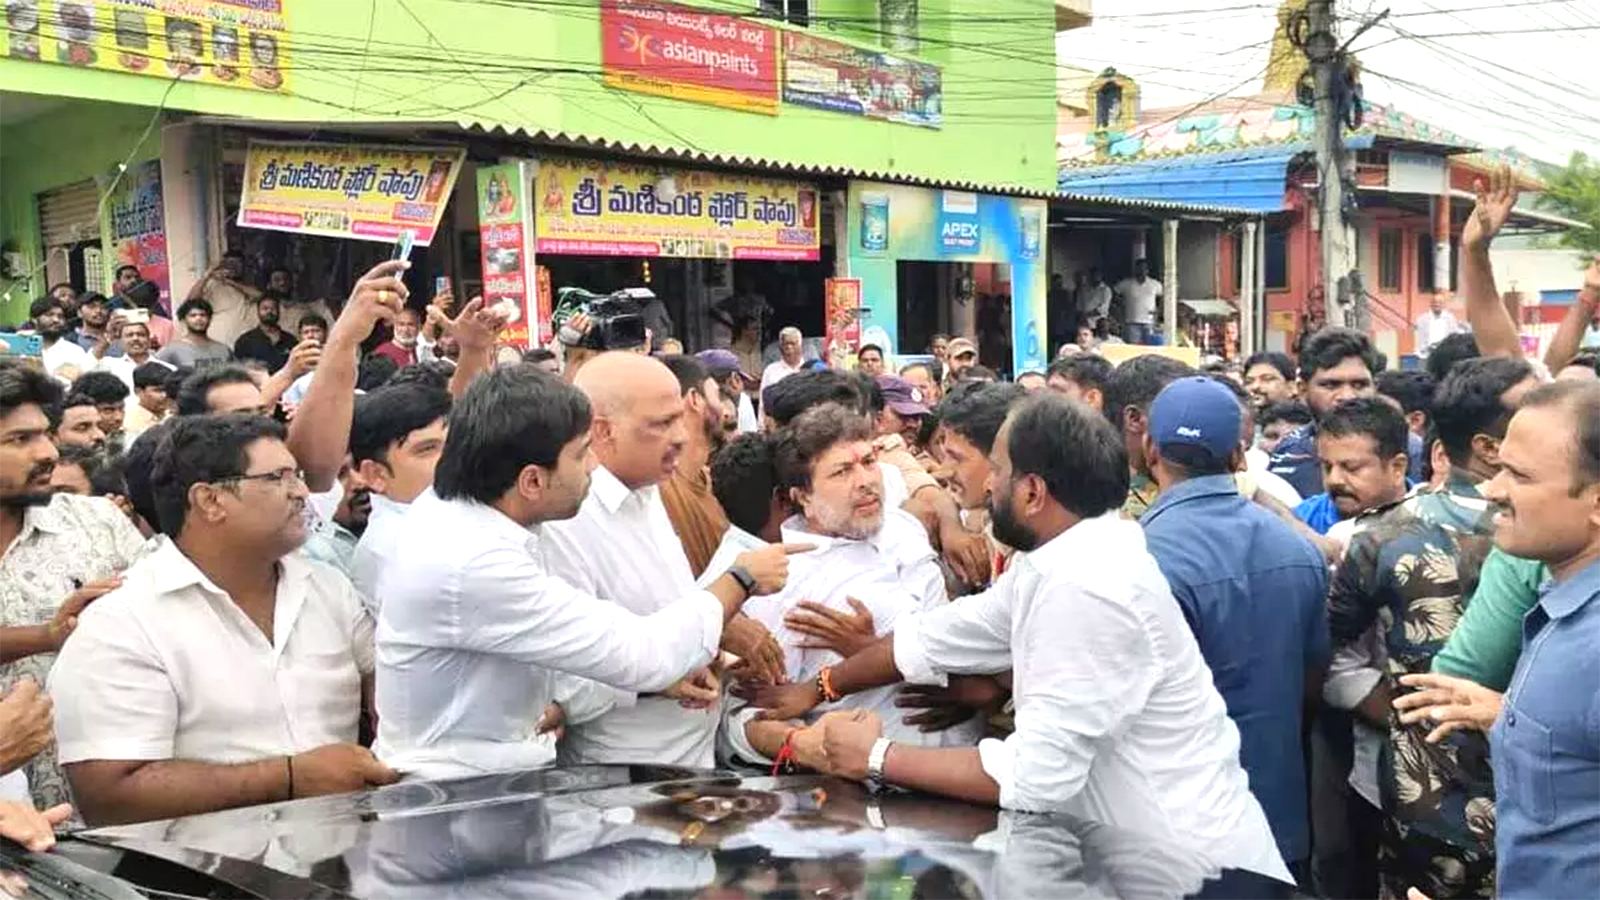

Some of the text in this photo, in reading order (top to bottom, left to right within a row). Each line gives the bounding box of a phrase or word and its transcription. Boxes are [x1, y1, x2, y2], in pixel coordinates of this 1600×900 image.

[662, 38, 758, 77] asianpaints
[260, 159, 279, 190] శ్రీ
[378, 168, 424, 200] షాపు
[572, 178, 601, 216] శ్రీ
[708, 190, 748, 227] ఫ్లోర్
[753, 195, 796, 227] షాపు
[941, 222, 979, 238] APEX
